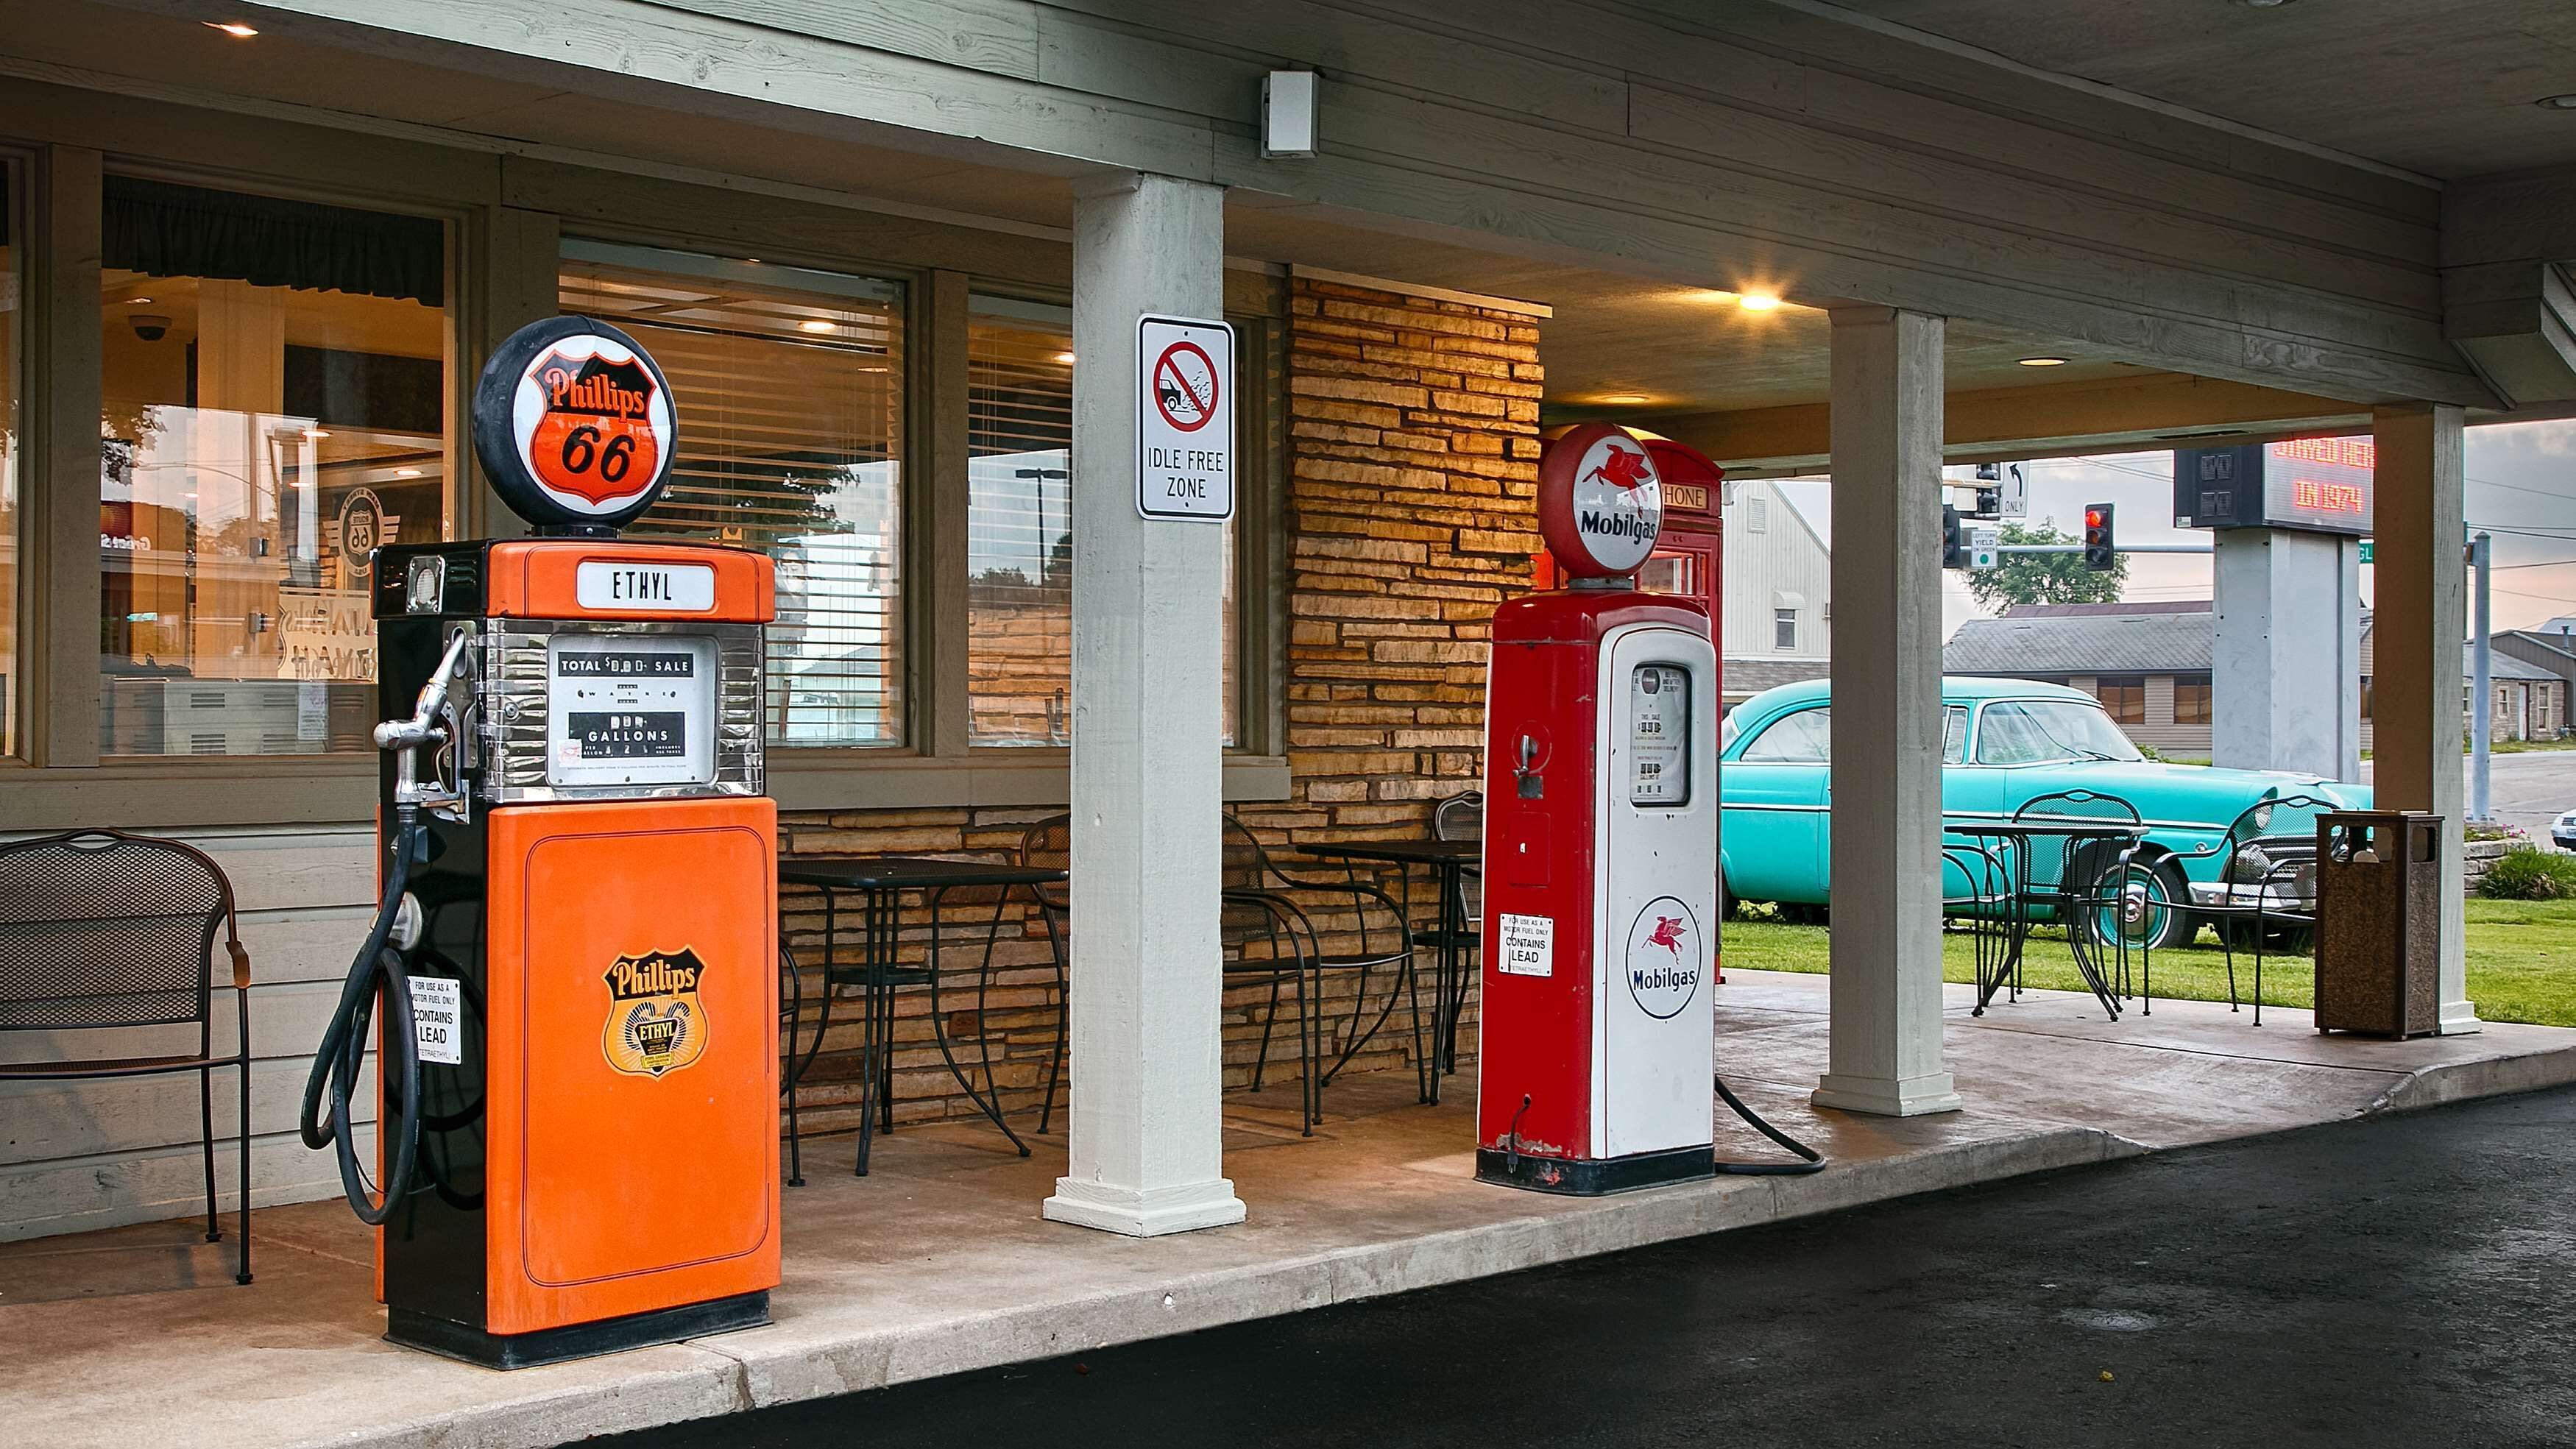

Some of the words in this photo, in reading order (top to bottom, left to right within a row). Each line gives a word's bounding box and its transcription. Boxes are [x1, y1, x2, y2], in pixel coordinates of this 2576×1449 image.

[545, 368, 645, 423] Phillips
[562, 425, 636, 483] 66
[1148, 447, 1181, 469] IDLE
[1188, 450, 1223, 472] FREE
[1167, 477, 1206, 498] ZONE
[1664, 486, 1703, 506] HONE
[2322, 483, 2363, 512] 1974
[2005, 501, 2024, 512] ONLY
[1581, 511, 1656, 545] Mobilgas
[613, 572, 672, 600] ETHYL
[562, 660, 601, 671] TOTAL
[655, 661, 688, 672] SALE
[588, 731, 668, 742] GALLONS
[1506, 937, 1546, 949] CONTAINS
[1512, 949, 1539, 963] LEAD
[415, 981, 424, 990] FOR
[427, 982, 436, 991] USE
[437, 983, 444, 991] AS
[612, 960, 696, 999] Phillips
[1633, 968, 1695, 992] Mobilgas
[429, 994, 441, 1004] FUEL
[442, 996, 455, 1005] ONLY
[414, 1008, 453, 1024] CONTAINS
[420, 1026, 447, 1044] LEAD
[640, 1021, 675, 1041] ETHYL
